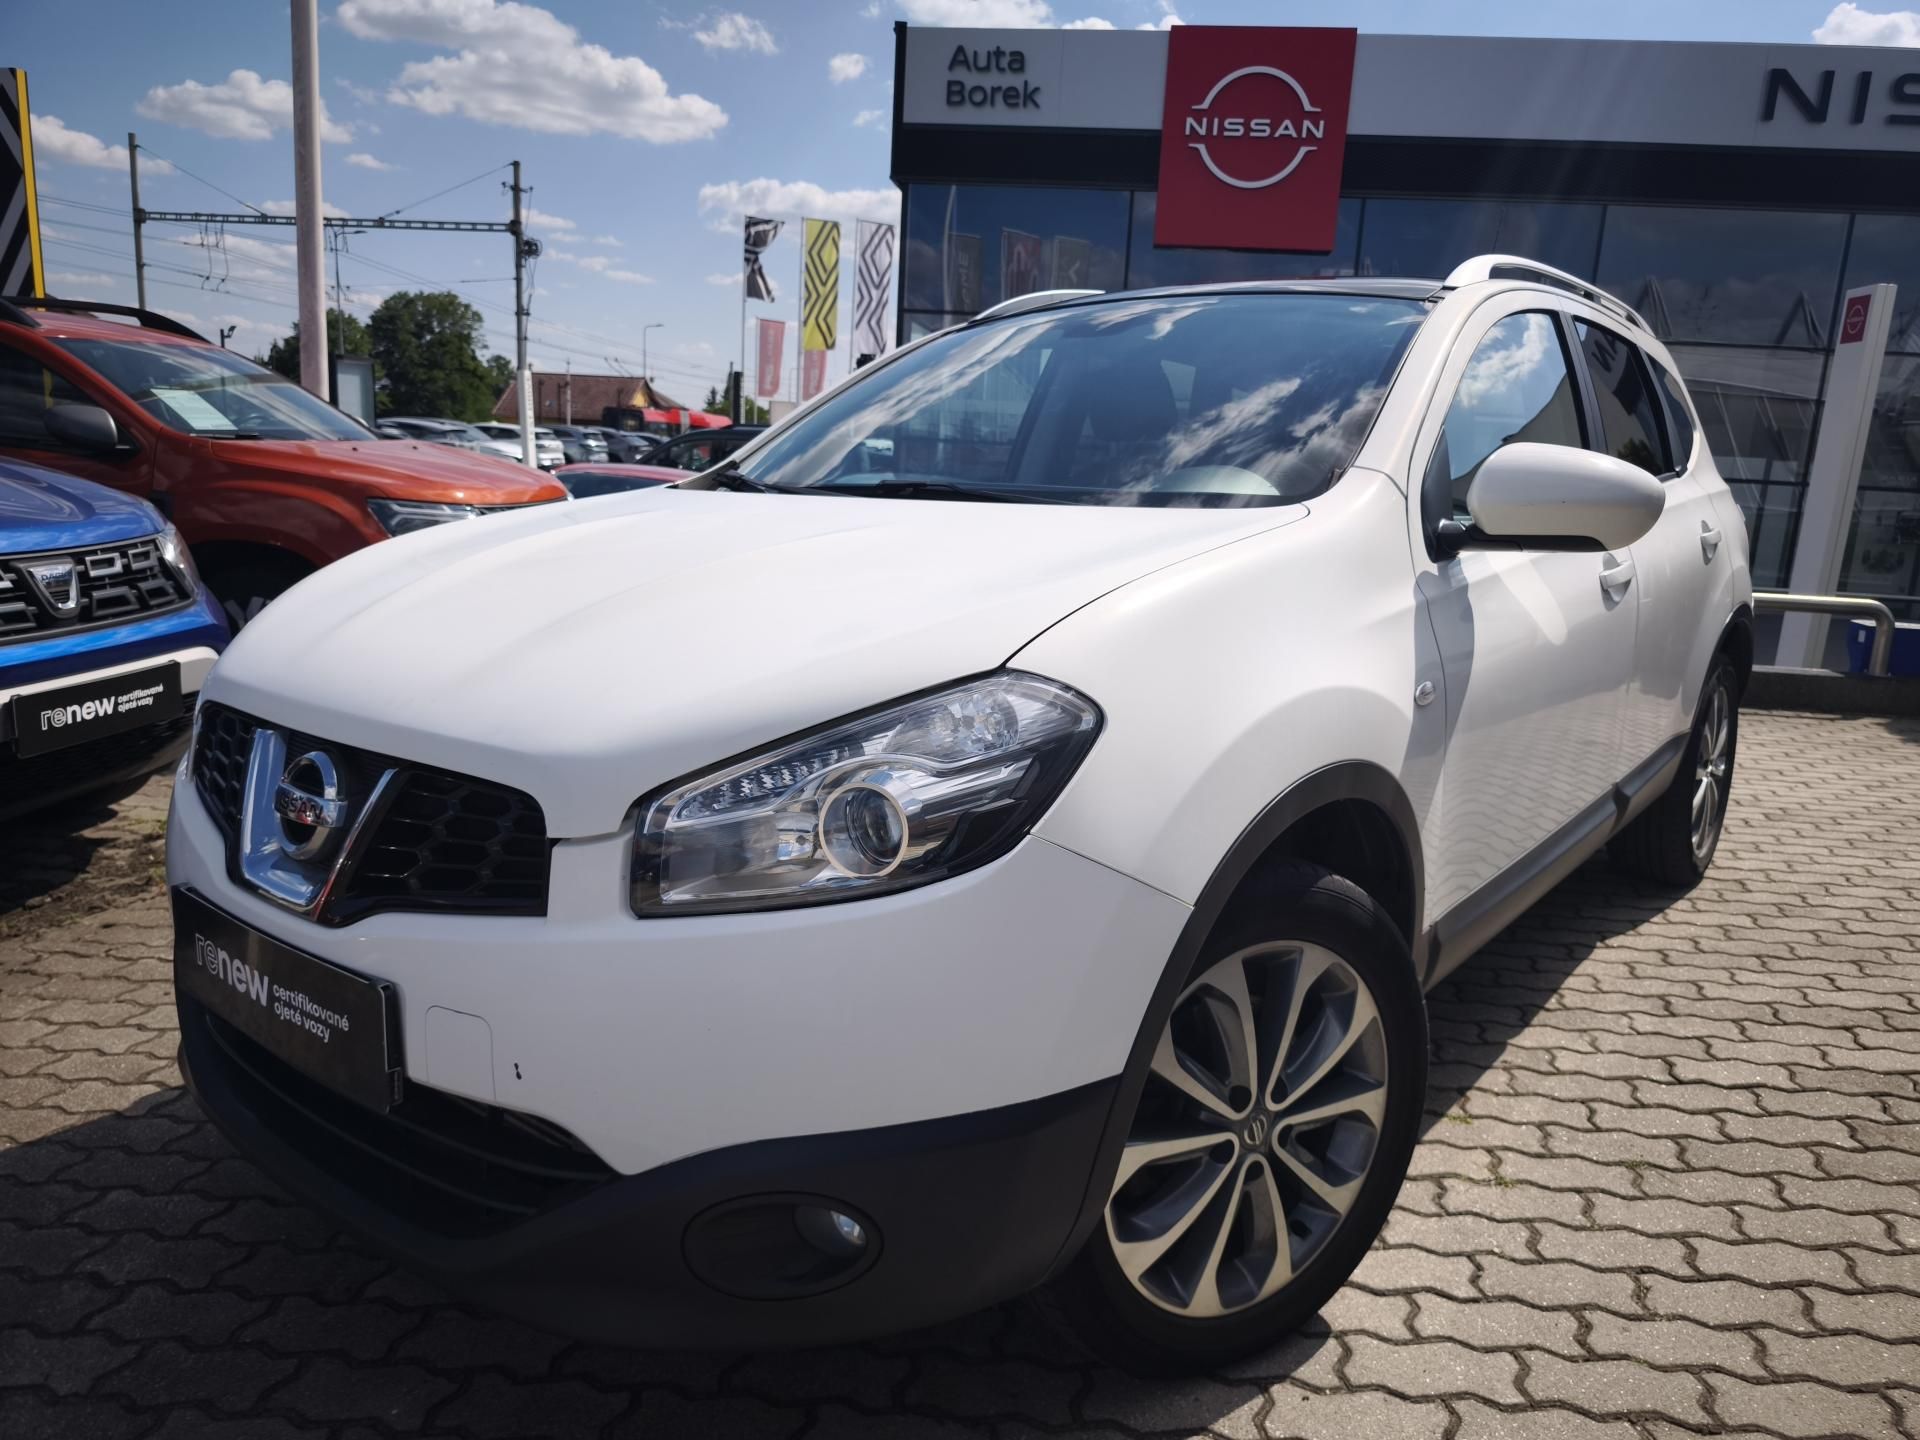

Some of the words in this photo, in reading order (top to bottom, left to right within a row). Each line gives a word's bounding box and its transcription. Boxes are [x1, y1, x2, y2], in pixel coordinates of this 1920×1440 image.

[947, 44, 1026, 74] Auta
[945, 80, 1041, 109] Borek
[1184, 116, 1325, 140] NISSAN
[40, 695, 116, 731] renew
[195, 932, 270, 1008] renew
[272, 983, 350, 1032] certifikované
[274, 1001, 302, 1026] ojeté
[302, 1016, 331, 1043] vozy
